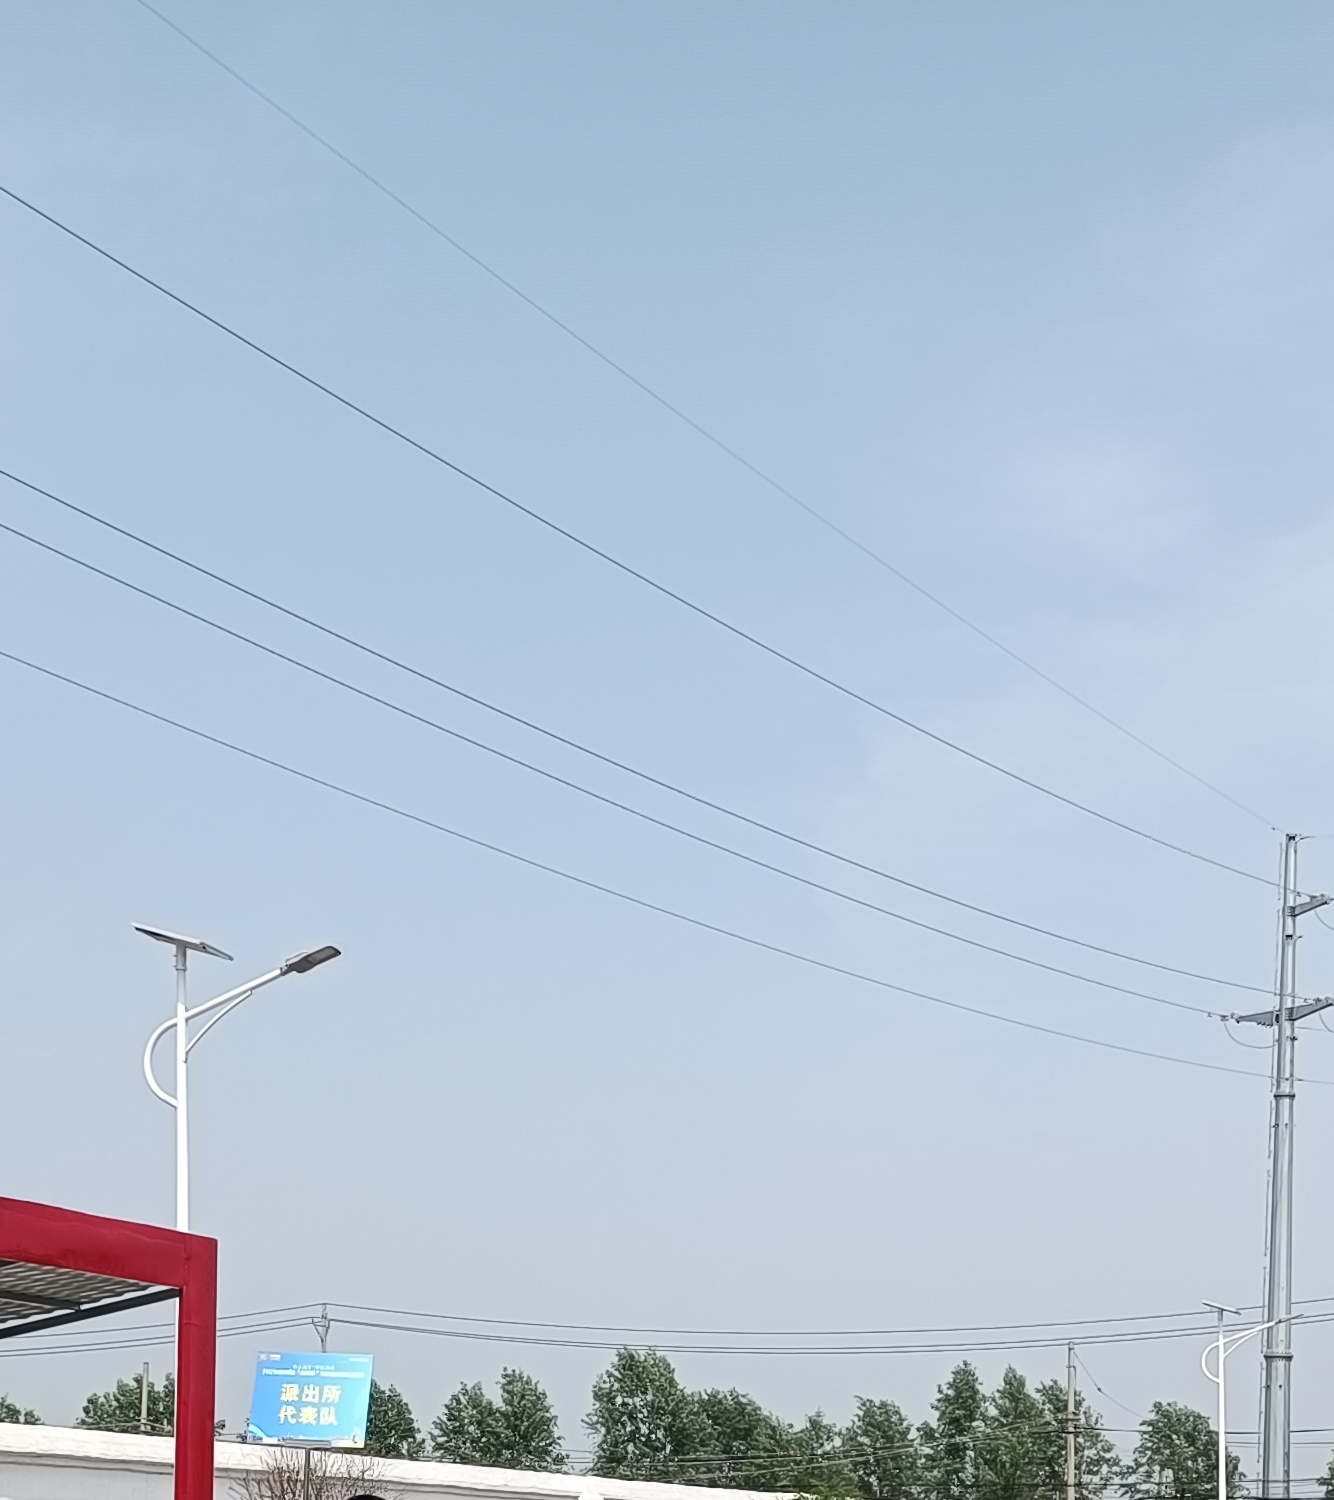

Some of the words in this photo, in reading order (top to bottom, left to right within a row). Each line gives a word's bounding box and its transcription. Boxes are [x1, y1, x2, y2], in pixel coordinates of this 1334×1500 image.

[280, 1383, 342, 1403] 派出所
[278, 1404, 338, 1425] 代表队
